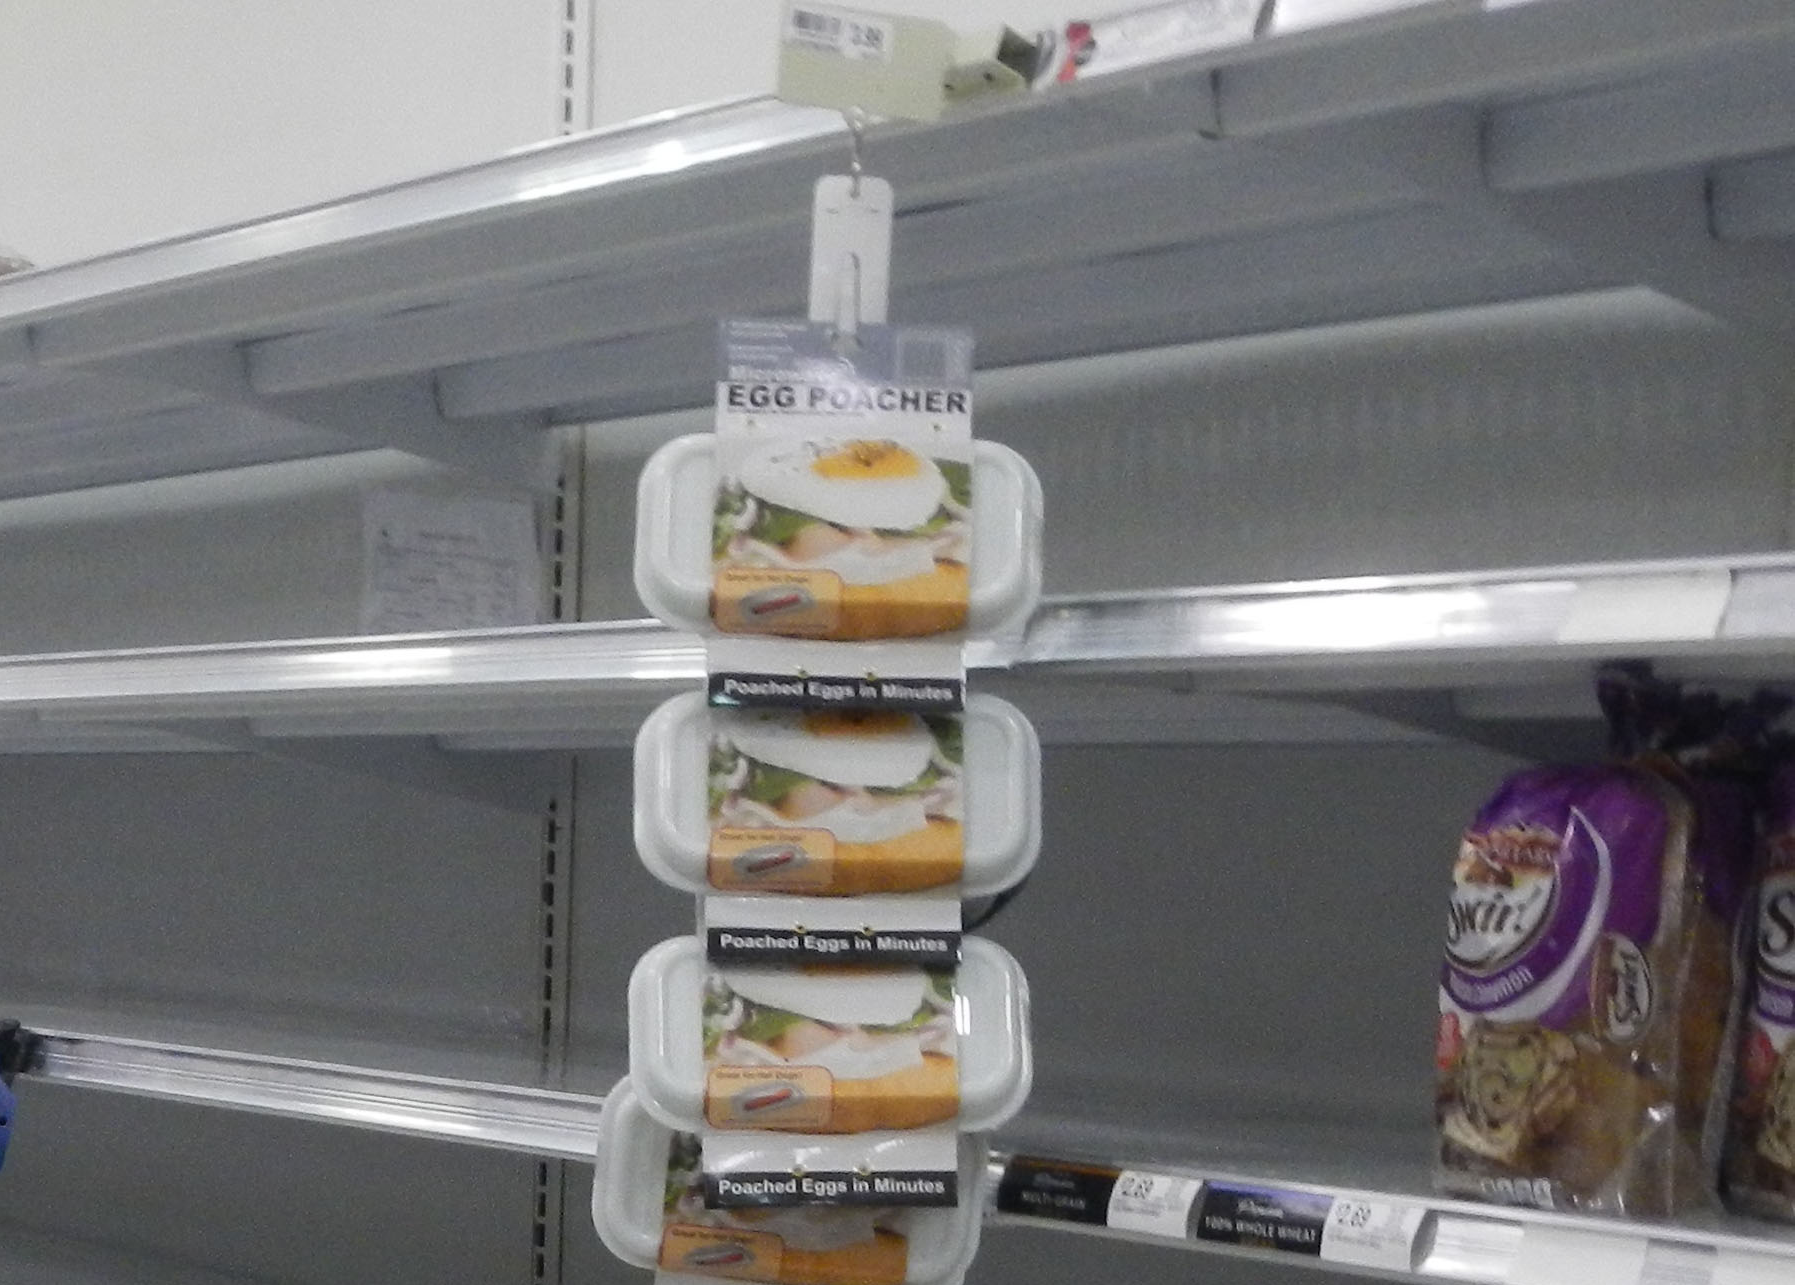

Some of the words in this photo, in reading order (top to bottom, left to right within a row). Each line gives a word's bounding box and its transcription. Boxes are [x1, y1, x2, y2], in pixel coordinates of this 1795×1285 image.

[729, 385, 796, 408] EGG
[808, 386, 968, 414] POACHER
[724, 679, 804, 696] Poached
[808, 681, 855, 700] Eggs
[858, 684, 878, 698] in
[881, 684, 954, 700] Minutes
[720, 933, 799, 949] Poached
[804, 935, 850, 952] Eggs
[854, 936, 873, 950] in
[876, 937, 948, 952] Minutes
[719, 1179, 797, 1195] Poached
[802, 1178, 848, 1196] Eggs
[852, 1178, 870, 1193] in
[874, 1178, 945, 1194] Minutes
